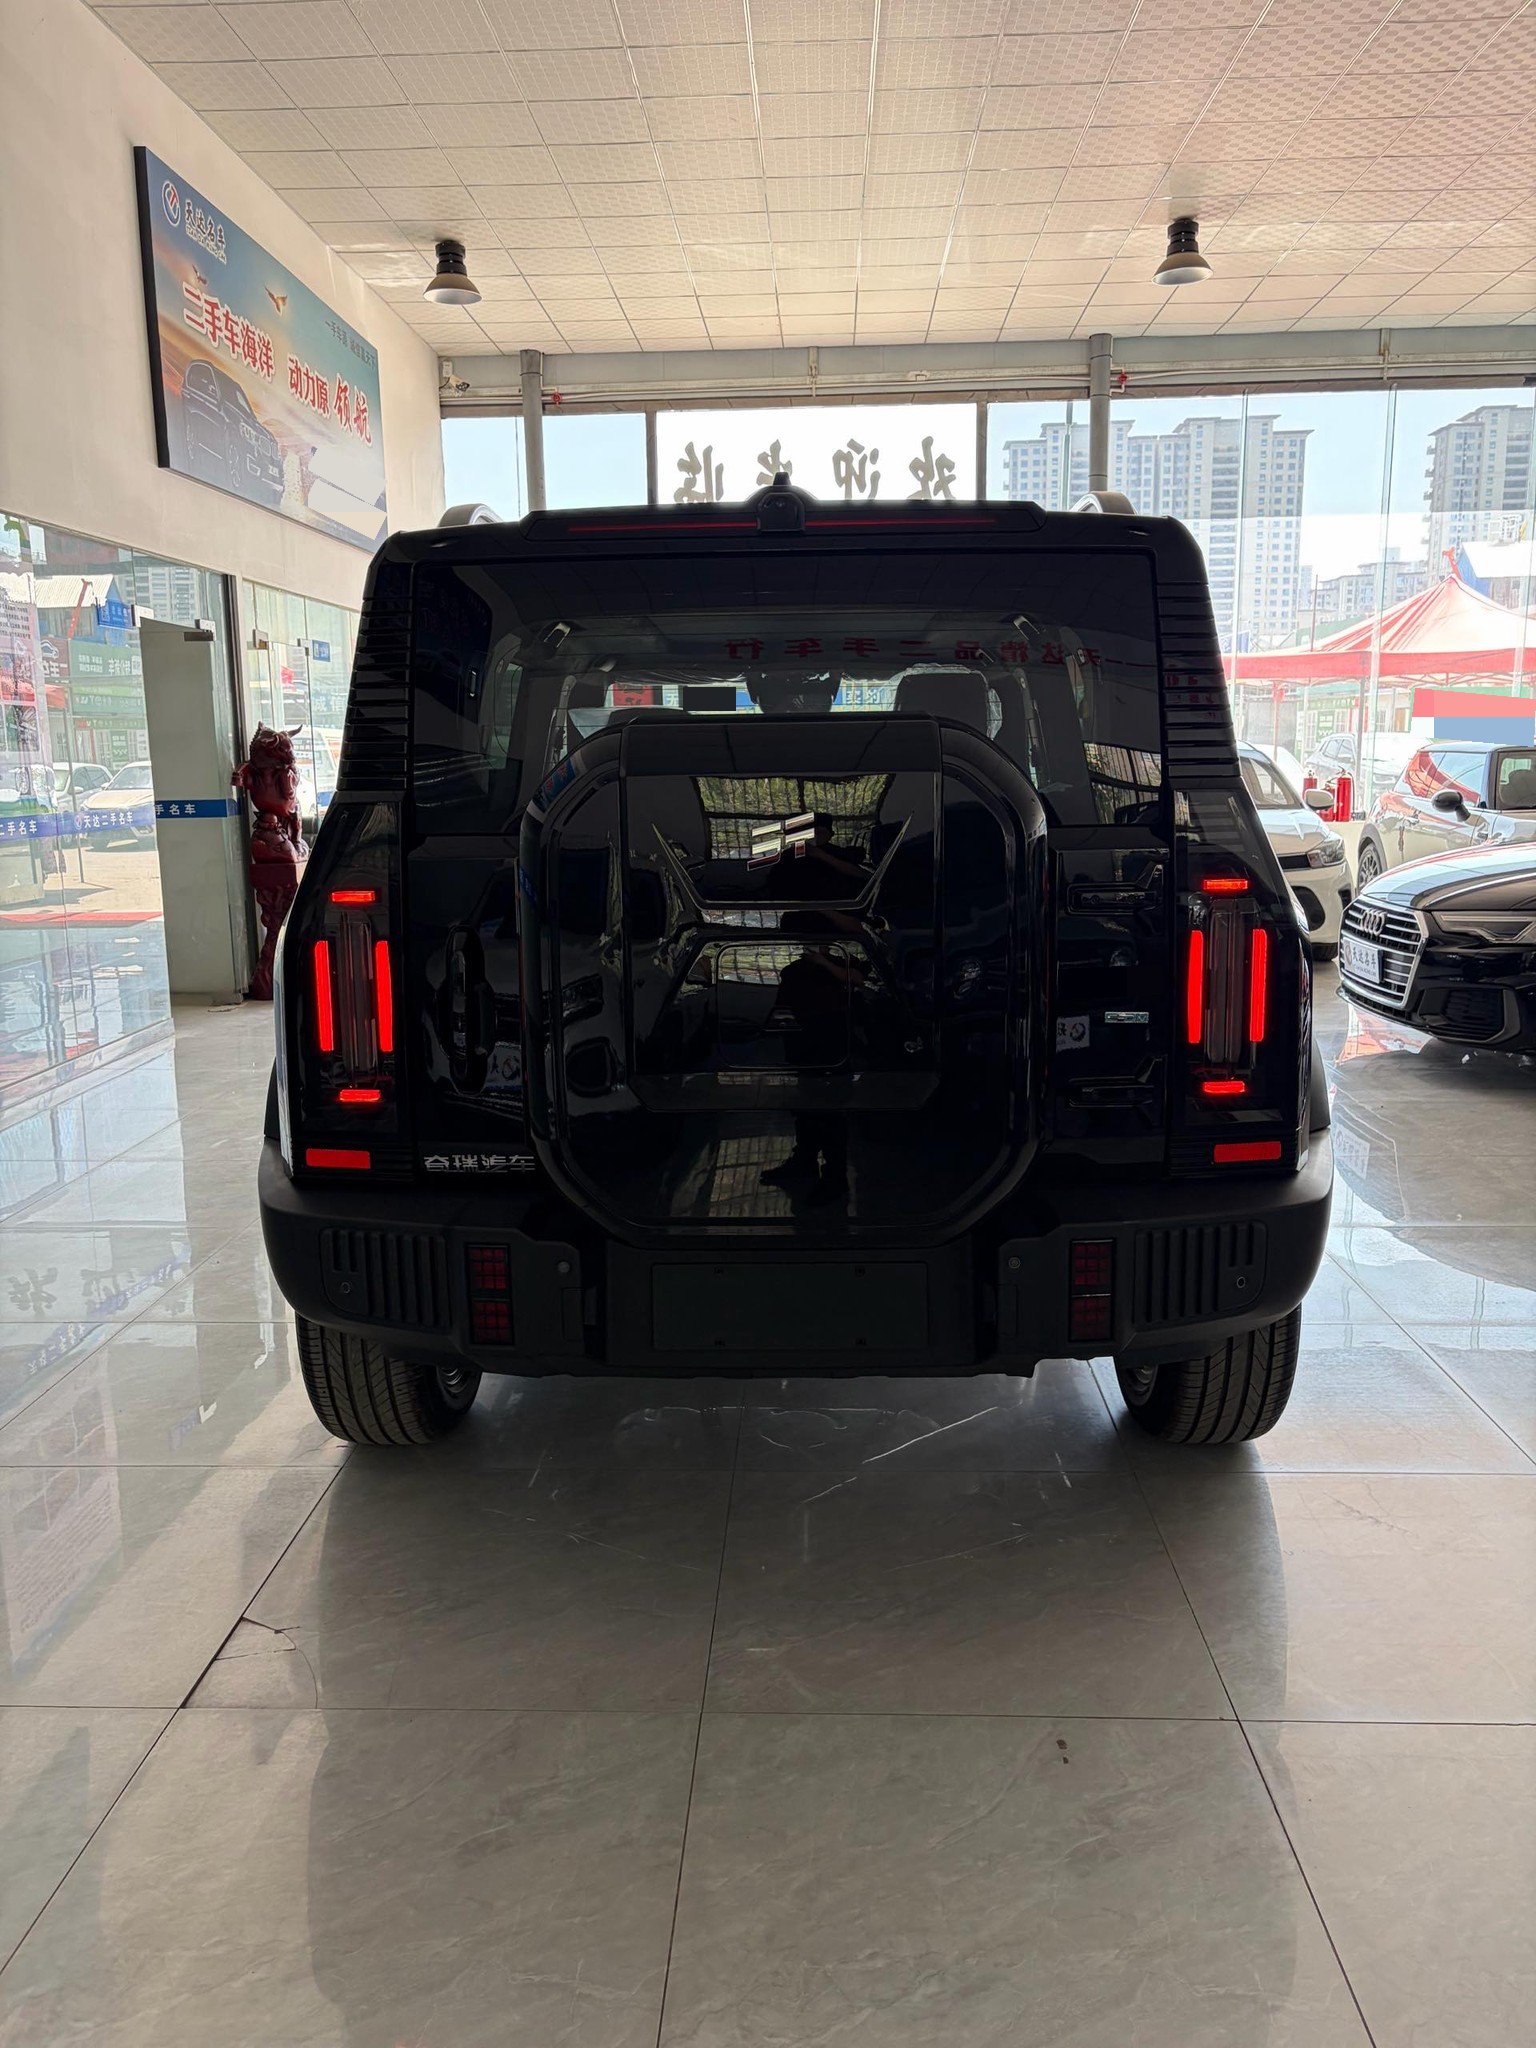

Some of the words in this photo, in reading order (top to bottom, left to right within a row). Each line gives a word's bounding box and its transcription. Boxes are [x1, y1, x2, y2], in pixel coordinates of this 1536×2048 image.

[184, 284, 275, 381] 二手车海洋
[288, 354, 330, 416] 动力原
[334, 373, 373, 445] 领航
[83, 811, 134, 829] 天达二手名车
[424, 1154, 535, 1173] 奇瑞汽车
